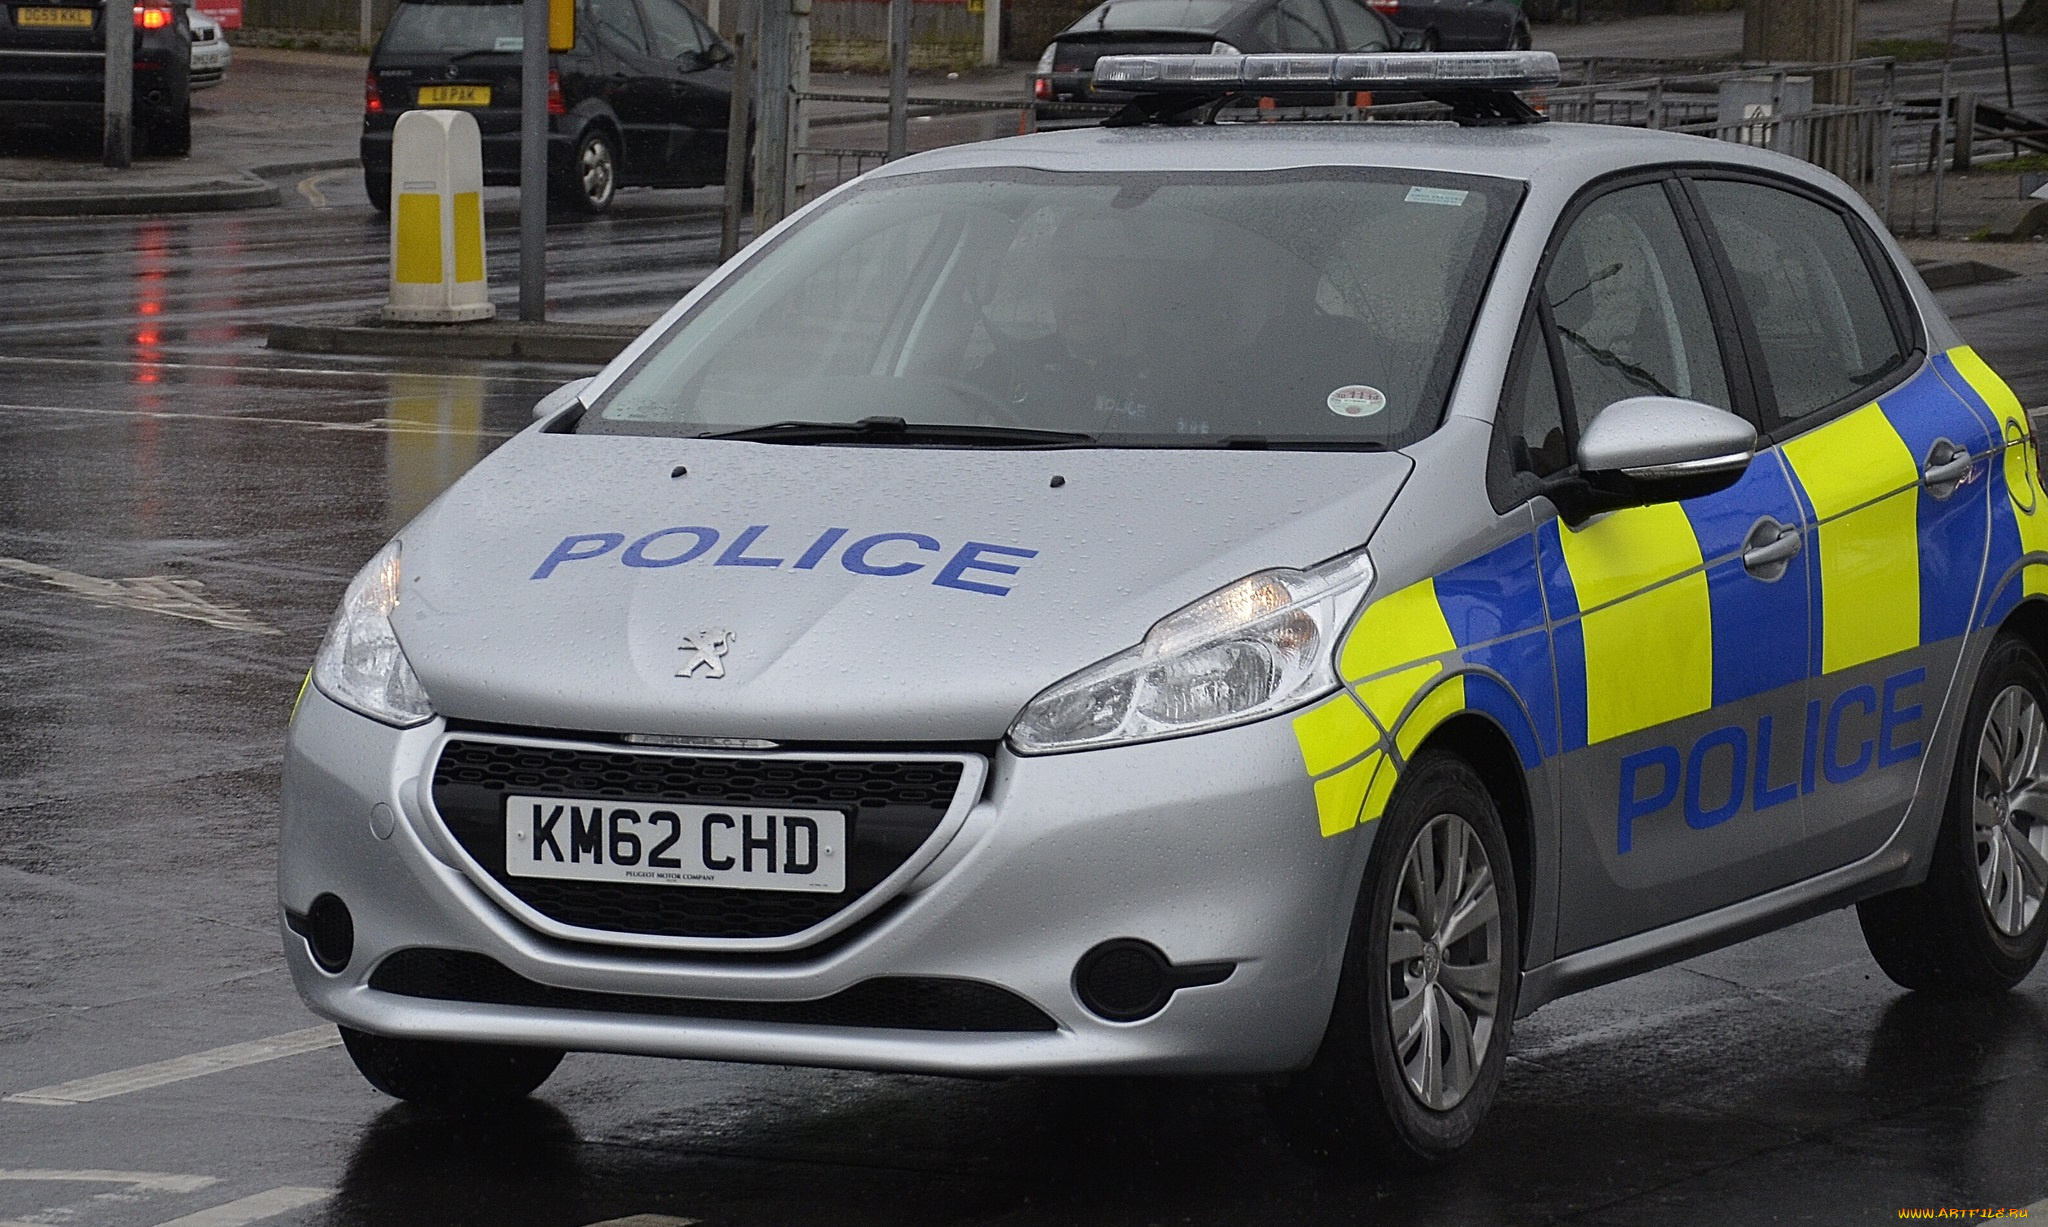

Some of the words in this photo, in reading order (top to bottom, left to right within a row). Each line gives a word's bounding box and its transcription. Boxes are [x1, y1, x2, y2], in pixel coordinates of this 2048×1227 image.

[450, 86, 475, 101] PAK
[529, 525, 1039, 597] POLICE
[1617, 666, 1926, 856] POLICE
[532, 804, 682, 869] KM62
[702, 812, 819, 875] CHD
[625, 870, 655, 878] PEUGEOT
[682, 873, 715, 881] COMPANY
